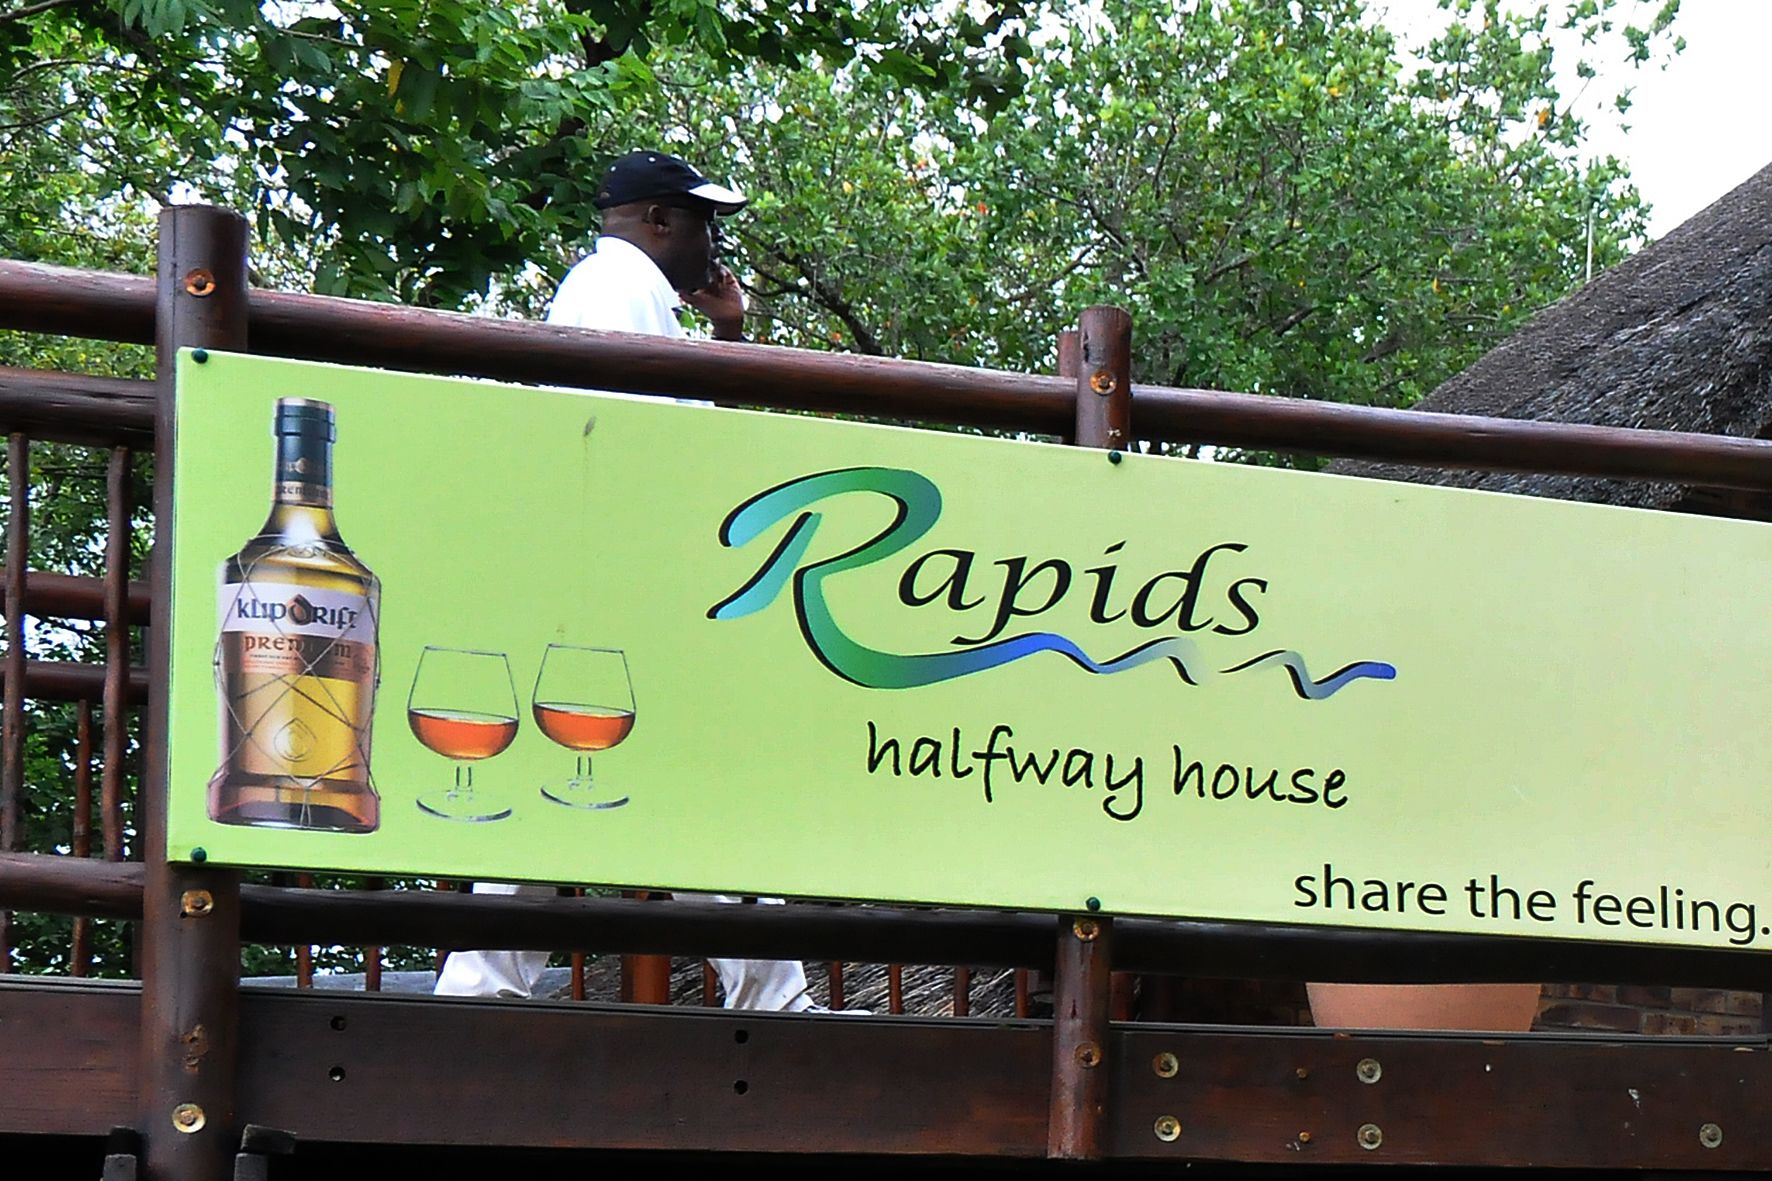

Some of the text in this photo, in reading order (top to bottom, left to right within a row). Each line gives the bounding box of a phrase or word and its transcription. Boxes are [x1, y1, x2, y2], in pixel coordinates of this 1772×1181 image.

[706, 466, 1270, 690] Rapids
[867, 721, 1349, 821] halfway house
[1293, 863, 1448, 915] share
[1464, 874, 1557, 922] the
